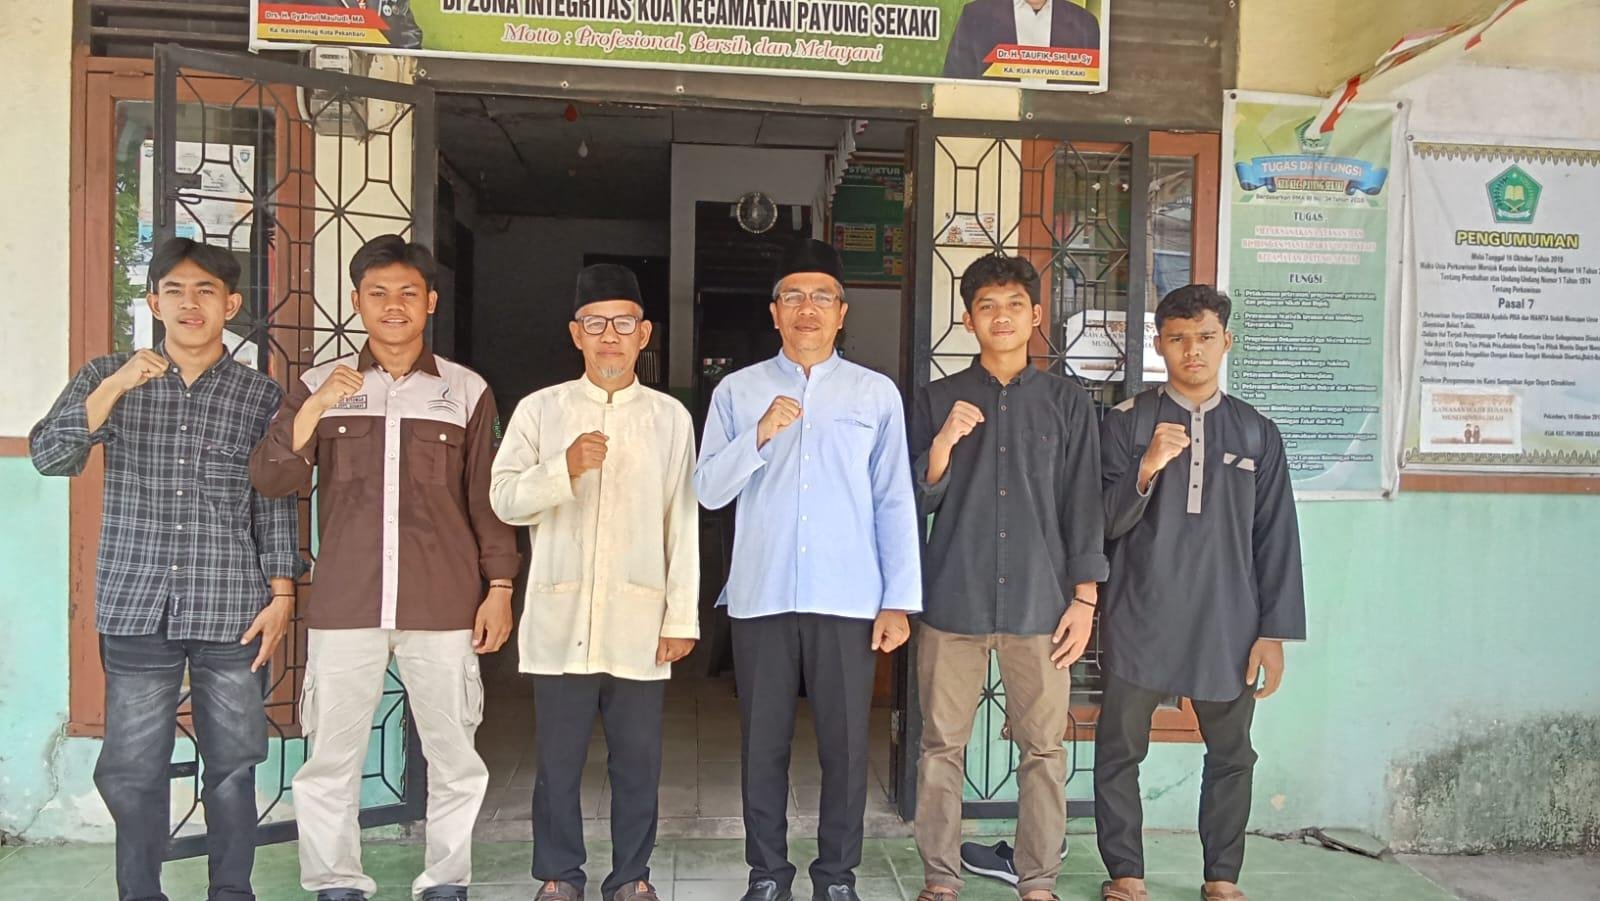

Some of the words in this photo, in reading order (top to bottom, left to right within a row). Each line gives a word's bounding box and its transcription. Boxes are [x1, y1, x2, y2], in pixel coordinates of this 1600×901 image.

[352, 16, 364, 24] MA
[525, 0, 632, 20] INTEGRITAS
[638, 0, 675, 21] KUA
[681, 0, 791, 29] KECAMATAN
[798, 2, 868, 34] PAYUNG
[874, 6, 938, 37] SEKAKI
[503, 24, 561, 43] Motto
[577, 26, 685, 52] Profesional,
[691, 33, 750, 54] Bersih
[755, 37, 790, 57] dan
[794, 40, 883, 64] Melayani
[997, 50, 1009, 59] Dr.
[1011, 50, 1019, 59] H.
[1082, 55, 1092, 65] Sy
[1016, 67, 1030, 75] KUA
[1032, 68, 1059, 76] PAYUNG
[1061, 69, 1085, 77] SEKAKI
[1261, 160, 1298, 173] TUGAS
[1300, 160, 1324, 171] DAN
[1325, 161, 1363, 177] FUNGSI
[1294, 211, 1324, 222] TUGAS
[1455, 229, 1580, 250] PENGUMUMAN
[1289, 273, 1323, 284] FUNGSI
[1498, 297, 1525, 310] Pasal
[1527, 298, 1535, 310] 7
